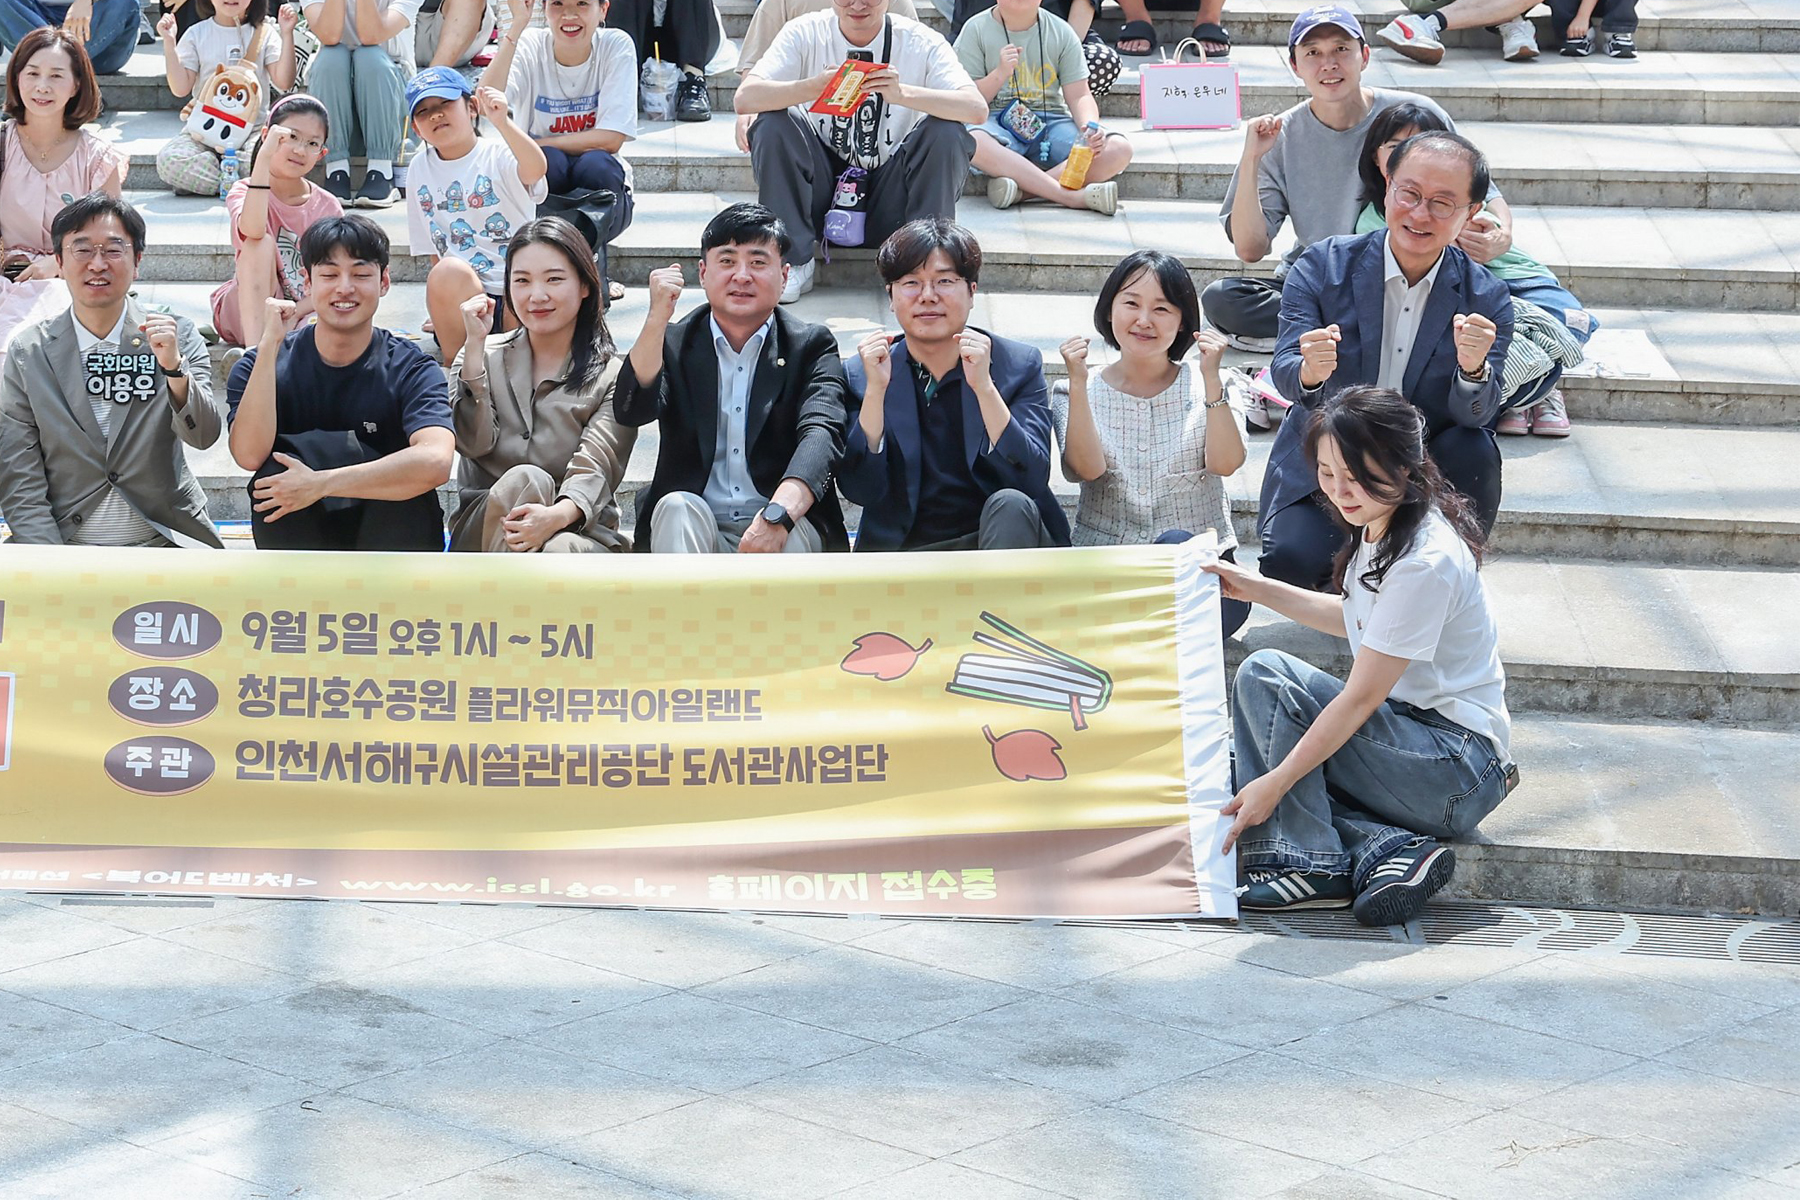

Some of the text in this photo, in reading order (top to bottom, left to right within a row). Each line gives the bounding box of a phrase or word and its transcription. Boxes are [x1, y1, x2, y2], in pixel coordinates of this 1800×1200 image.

[1193, 86, 1211, 99] 은우
[1214, 87, 1227, 97] 네
[549, 111, 597, 134] JAWS
[87, 353, 155, 375] 국회의원
[87, 373, 156, 403] 이용우
[241, 610, 307, 653] 9월
[318, 612, 379, 655] 5일
[237, 674, 457, 722] 청라호수공원
[467, 686, 763, 722] 플라워뮤직아일랜드
[234, 739, 673, 788] 인천서해구시설관리공단
[683, 745, 888, 786] 도서관사업단
[81, 870, 318, 888] <북어드벤처>
[339, 868, 997, 901] www.issl.go.kr 홈페이지 접수중
